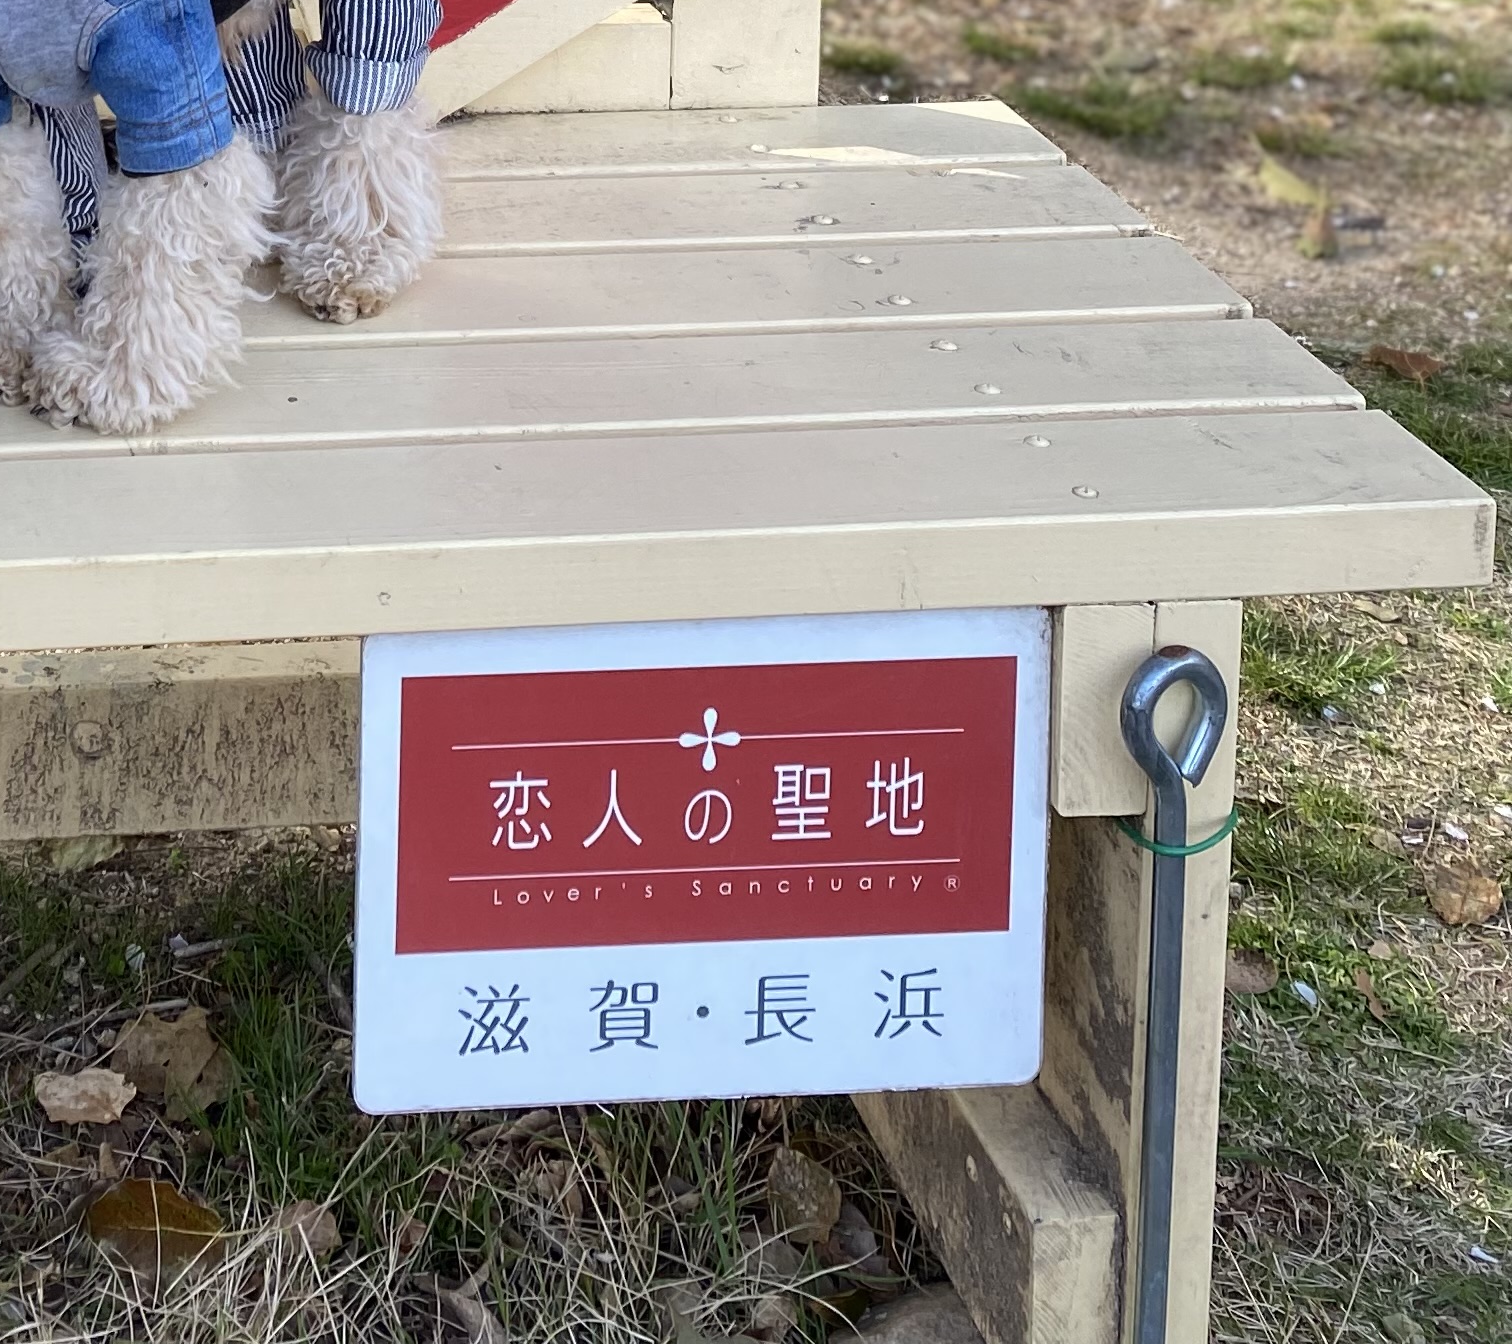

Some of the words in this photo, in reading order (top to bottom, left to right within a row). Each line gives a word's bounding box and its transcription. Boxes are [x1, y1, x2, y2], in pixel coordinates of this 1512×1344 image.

[488, 756, 925, 851] 恋人の聖地
[492, 879, 655, 907] Lover's
[457, 967, 945, 1057] 滋賀・長浜
